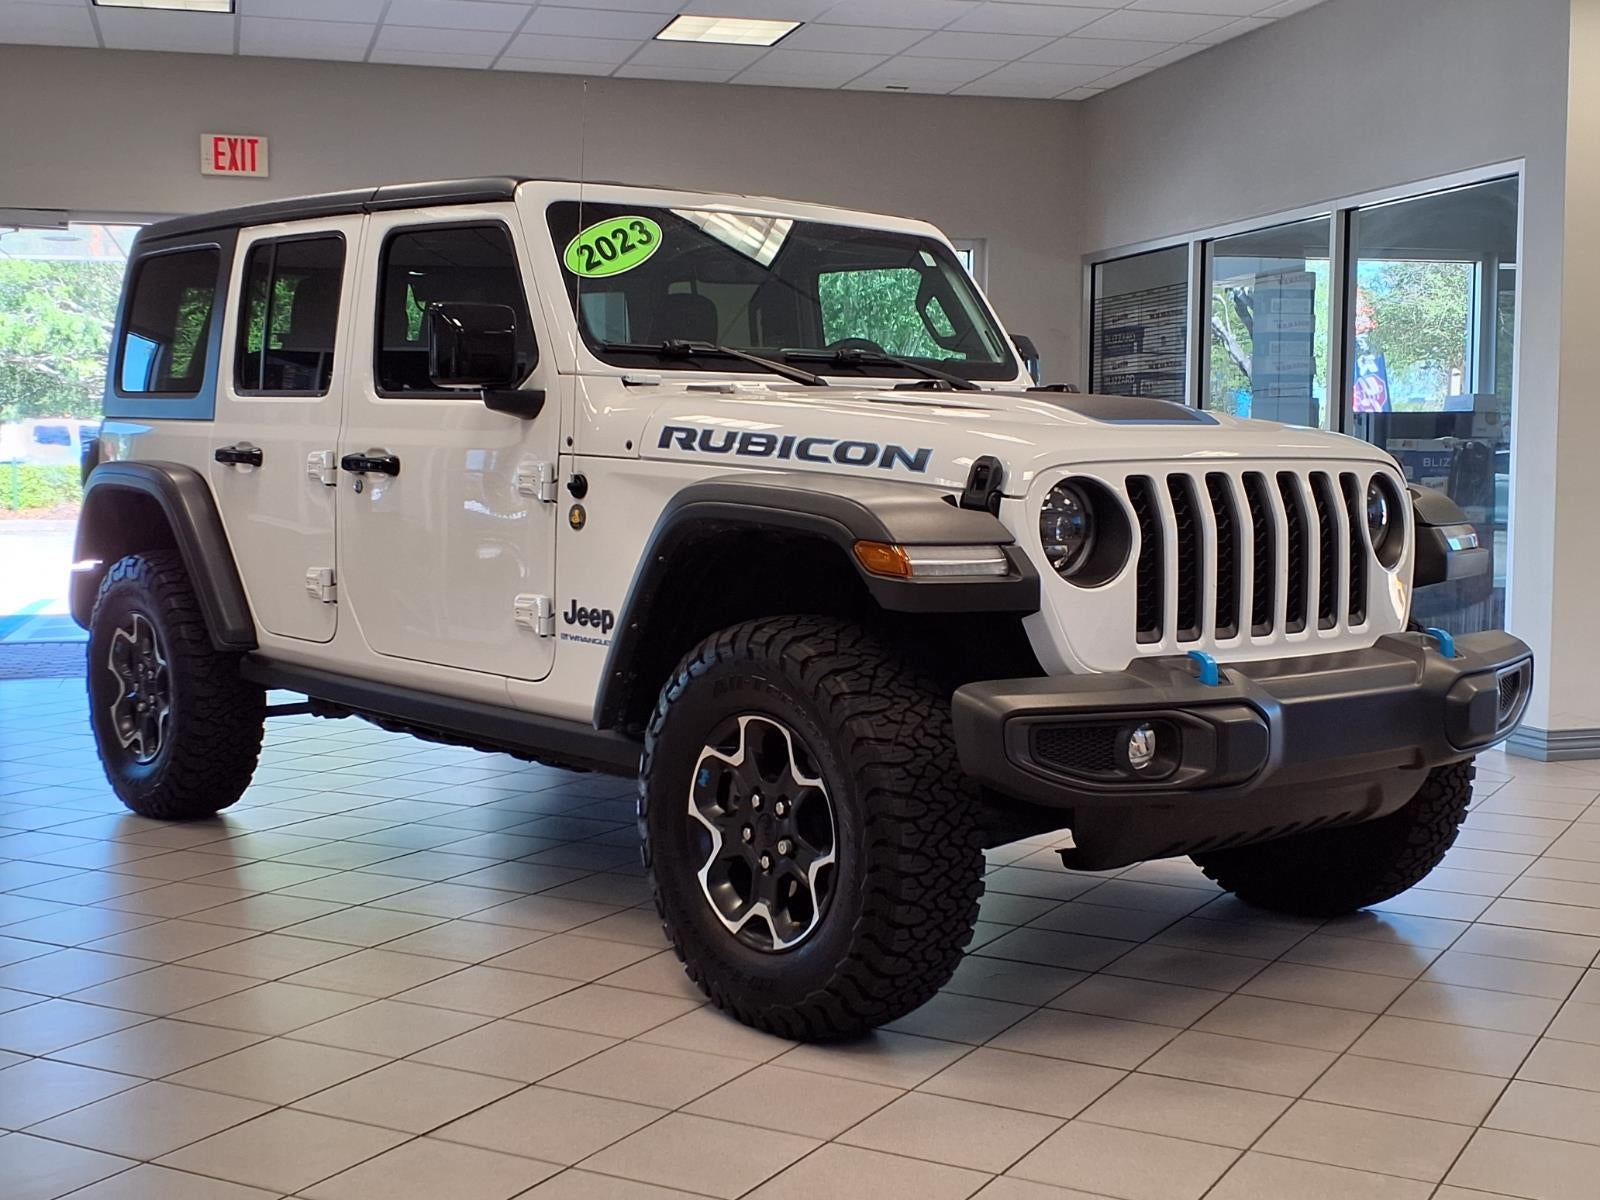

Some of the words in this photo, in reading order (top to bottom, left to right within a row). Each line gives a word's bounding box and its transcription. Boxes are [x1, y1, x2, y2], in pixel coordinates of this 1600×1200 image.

[214, 137, 258, 171] EXIT
[577, 220, 653, 271] 2023
[657, 425, 933, 473] RUBICON
[1423, 457, 1450, 467] BLIZ
[563, 598, 614, 634] Jeep
